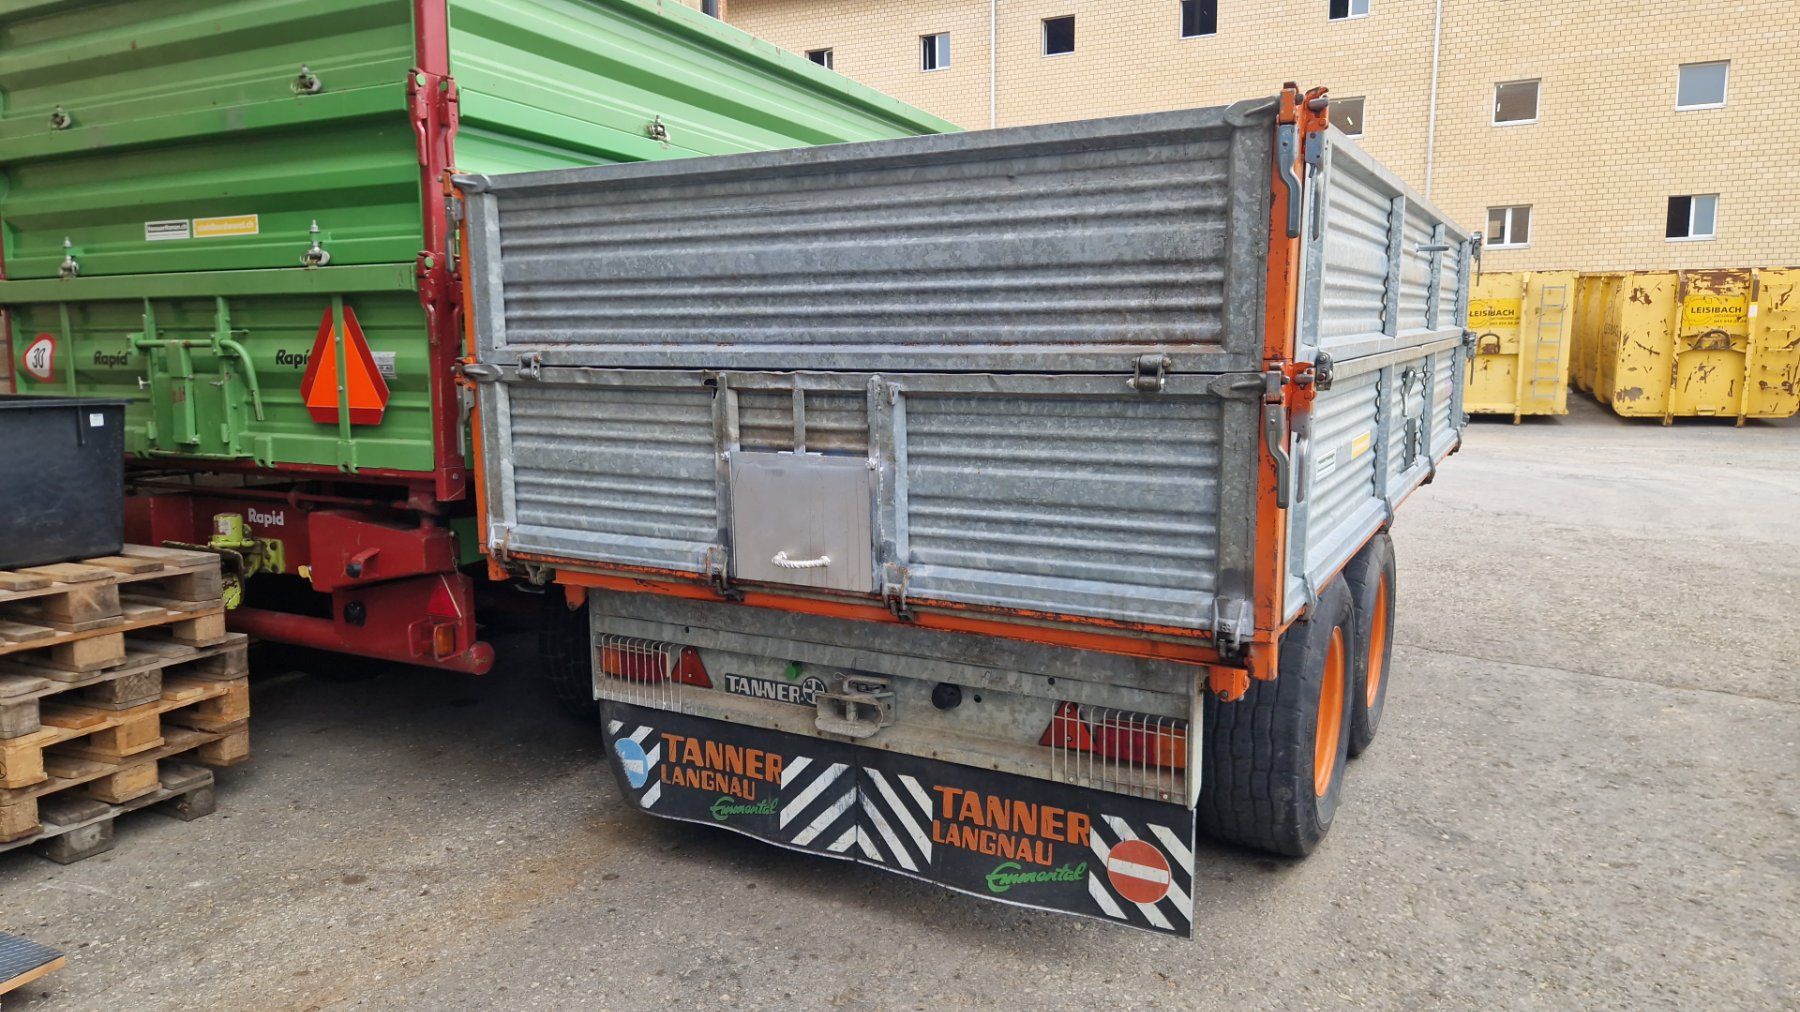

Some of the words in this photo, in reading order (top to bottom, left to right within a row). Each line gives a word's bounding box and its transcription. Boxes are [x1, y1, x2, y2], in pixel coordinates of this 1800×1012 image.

[1690, 306, 1742, 314] LEISIBACH
[32, 347, 46, 369] 30
[93, 350, 130, 368] Rapid
[275, 348, 311, 368] Rapi
[247, 506, 285, 528] Rapid
[725, 673, 801, 704] TANNER
[660, 732, 783, 785] TANNER
[660, 763, 756, 801] LANGNAU
[932, 784, 1091, 848] TANNER
[932, 819, 1053, 867] LANGNAU
[985, 861, 1088, 893] Emmental
